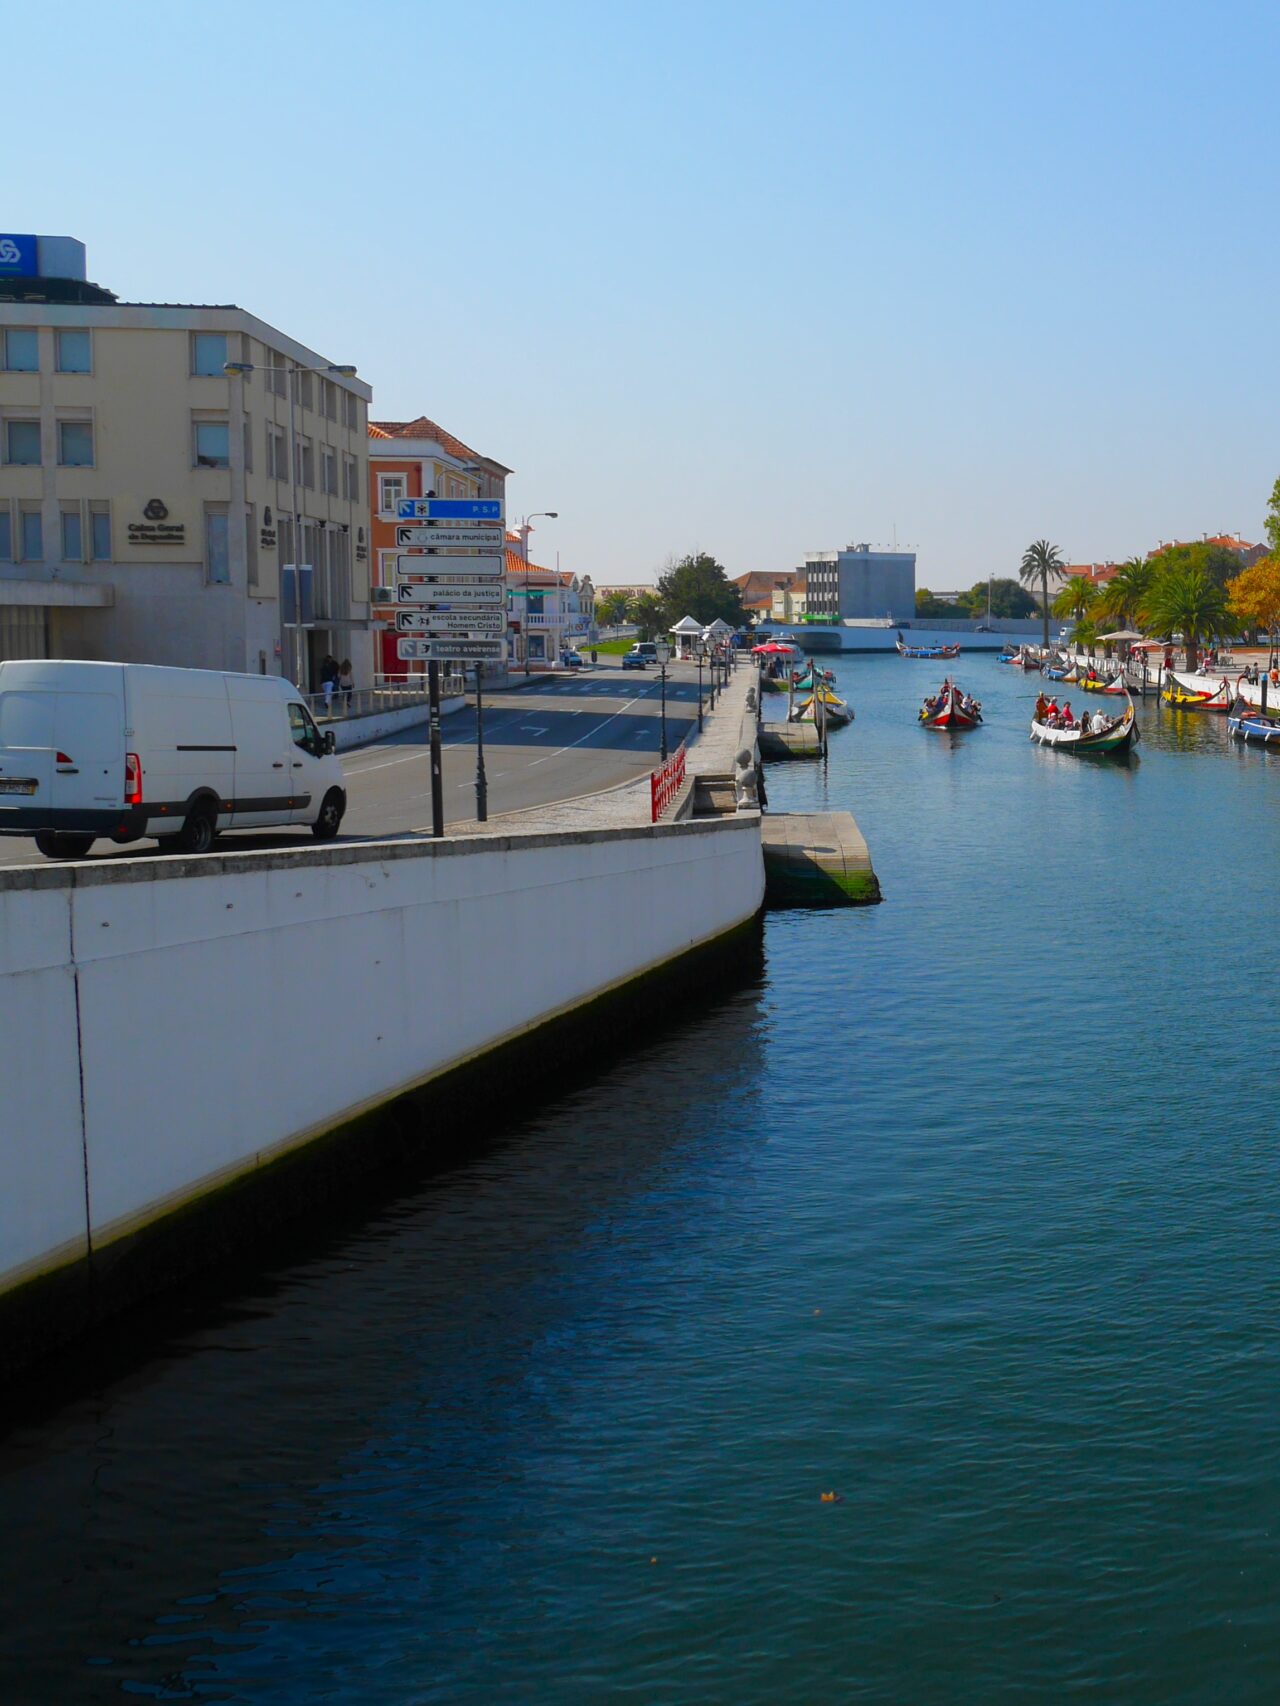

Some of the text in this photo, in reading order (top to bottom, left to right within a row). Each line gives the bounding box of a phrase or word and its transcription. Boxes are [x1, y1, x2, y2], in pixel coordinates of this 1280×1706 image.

[462, 533, 499, 542] municipal
[433, 590, 461, 598] palácio
[474, 590, 500, 598] justiça
[463, 645, 500, 653] aveirense
